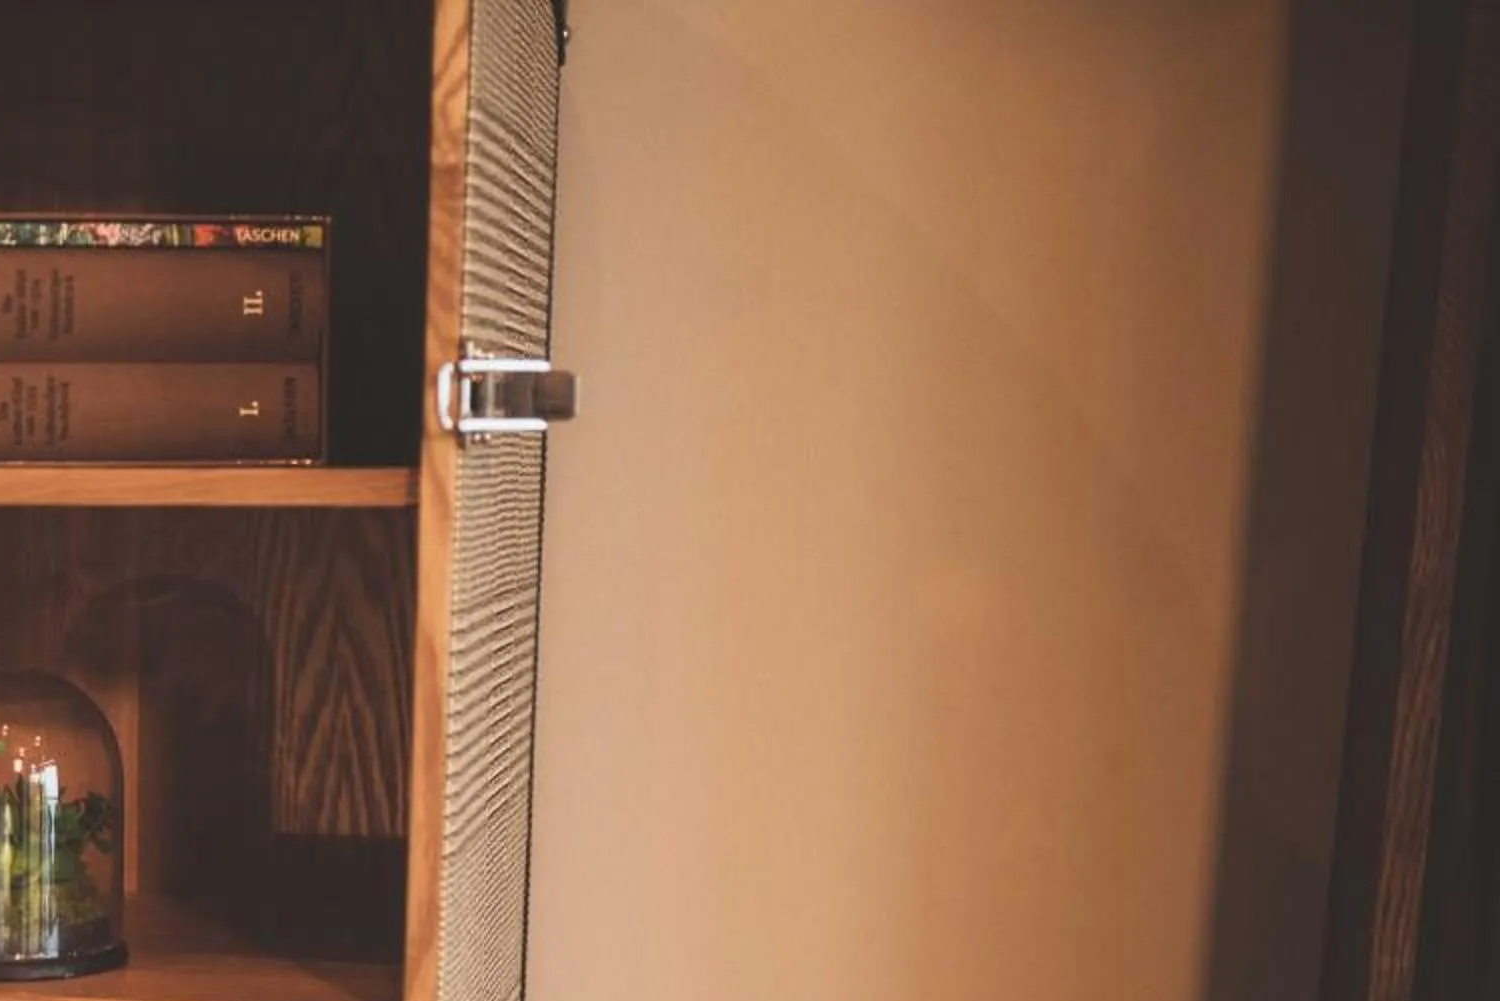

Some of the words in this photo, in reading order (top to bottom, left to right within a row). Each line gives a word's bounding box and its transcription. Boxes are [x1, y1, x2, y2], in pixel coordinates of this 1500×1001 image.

[235, 225, 300, 243] TASCHEN
[243, 291, 263, 315] II.
[239, 400, 259, 417] I.
